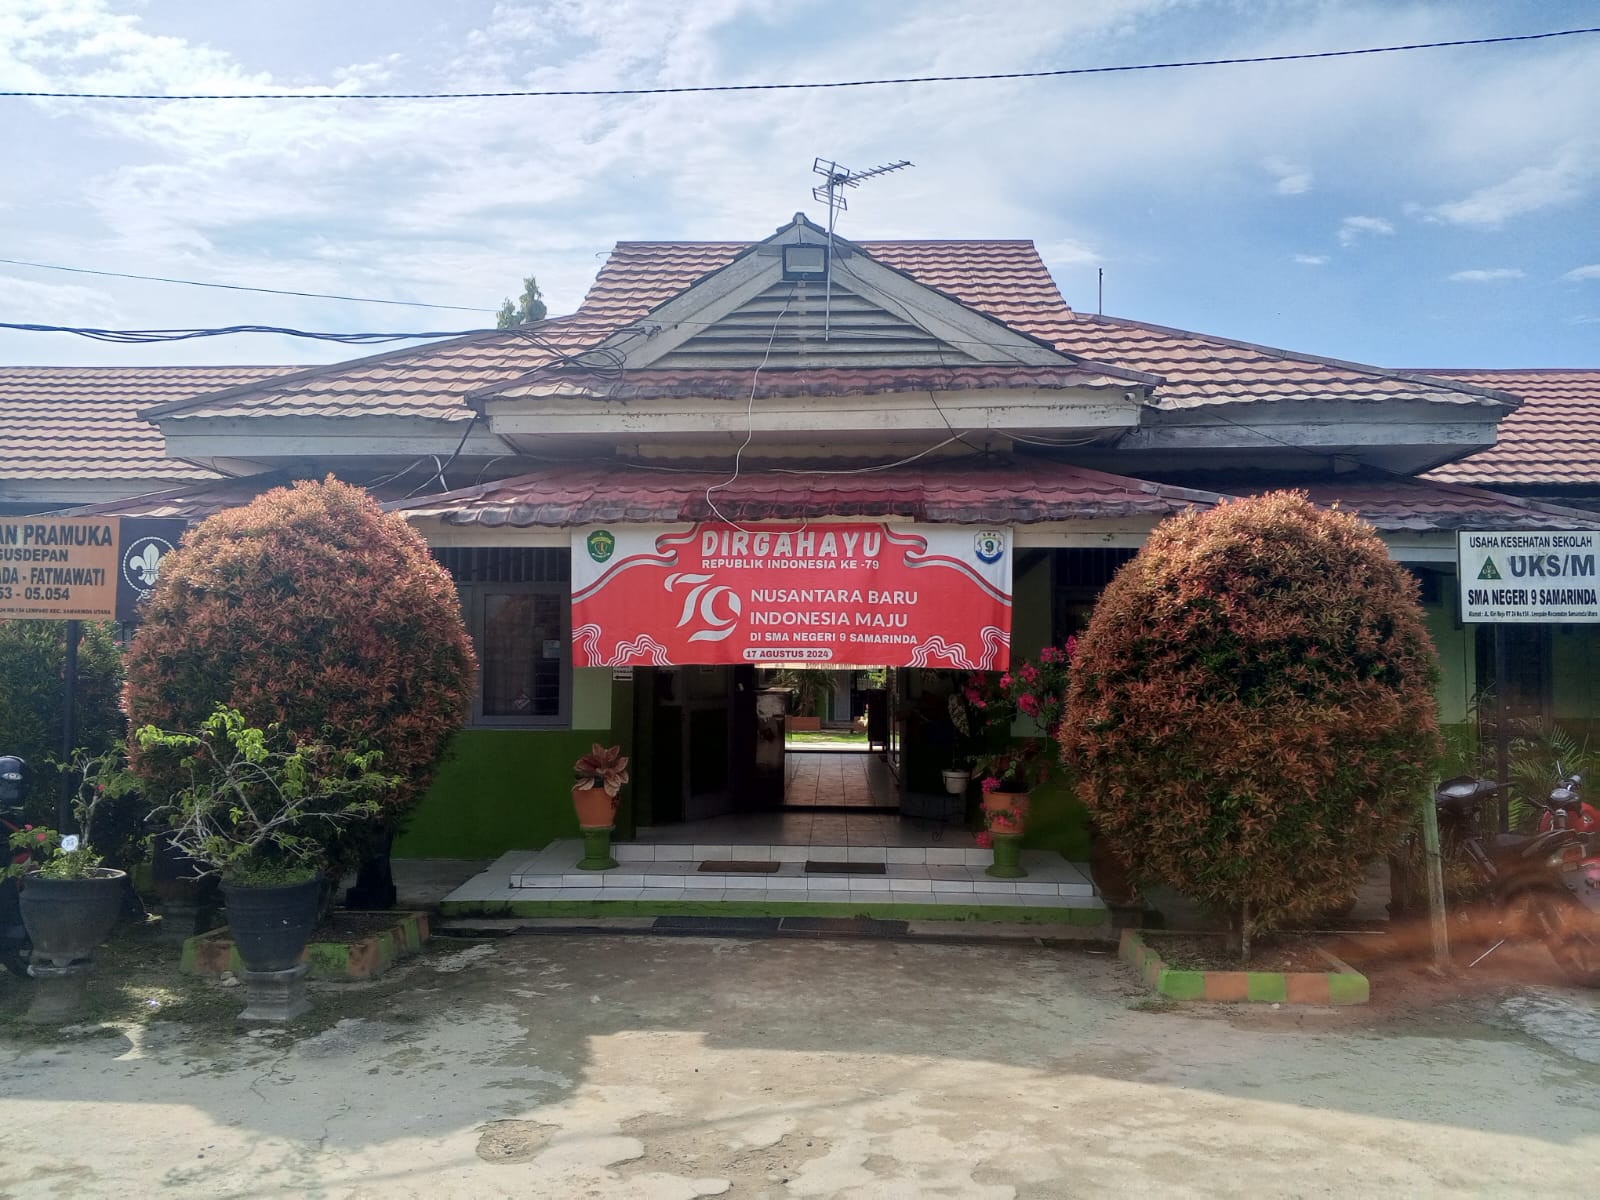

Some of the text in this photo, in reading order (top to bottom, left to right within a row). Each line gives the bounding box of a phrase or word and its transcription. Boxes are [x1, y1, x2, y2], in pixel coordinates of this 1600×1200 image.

[23, 525, 113, 546] PRAMUKA
[701, 530, 881, 557] DIRGAHAYU
[1469, 536, 1592, 548] USAHA KESEHATAN SEKOLAH
[701, 559, 881, 570] REPUBLIK INDONESIA KE -79
[1510, 554, 1596, 577] UKS/M
[0, 566, 19, 585] DA
[30, 567, 105, 586] FATMAWATI
[24, 587, 70, 600] 05.054
[750, 589, 918, 605] NUSANTARA BARU
[1468, 589, 1598, 605] SMA NEGERI 9 SAMARINDA
[663, 572, 742, 643] 79
[750, 611, 908, 628] INDONESIA MAJU
[750, 632, 918, 644] DI SMA NEGERI 9 SAMARINDA
[746, 650, 829, 658] 17 AGUSTUS 2024
